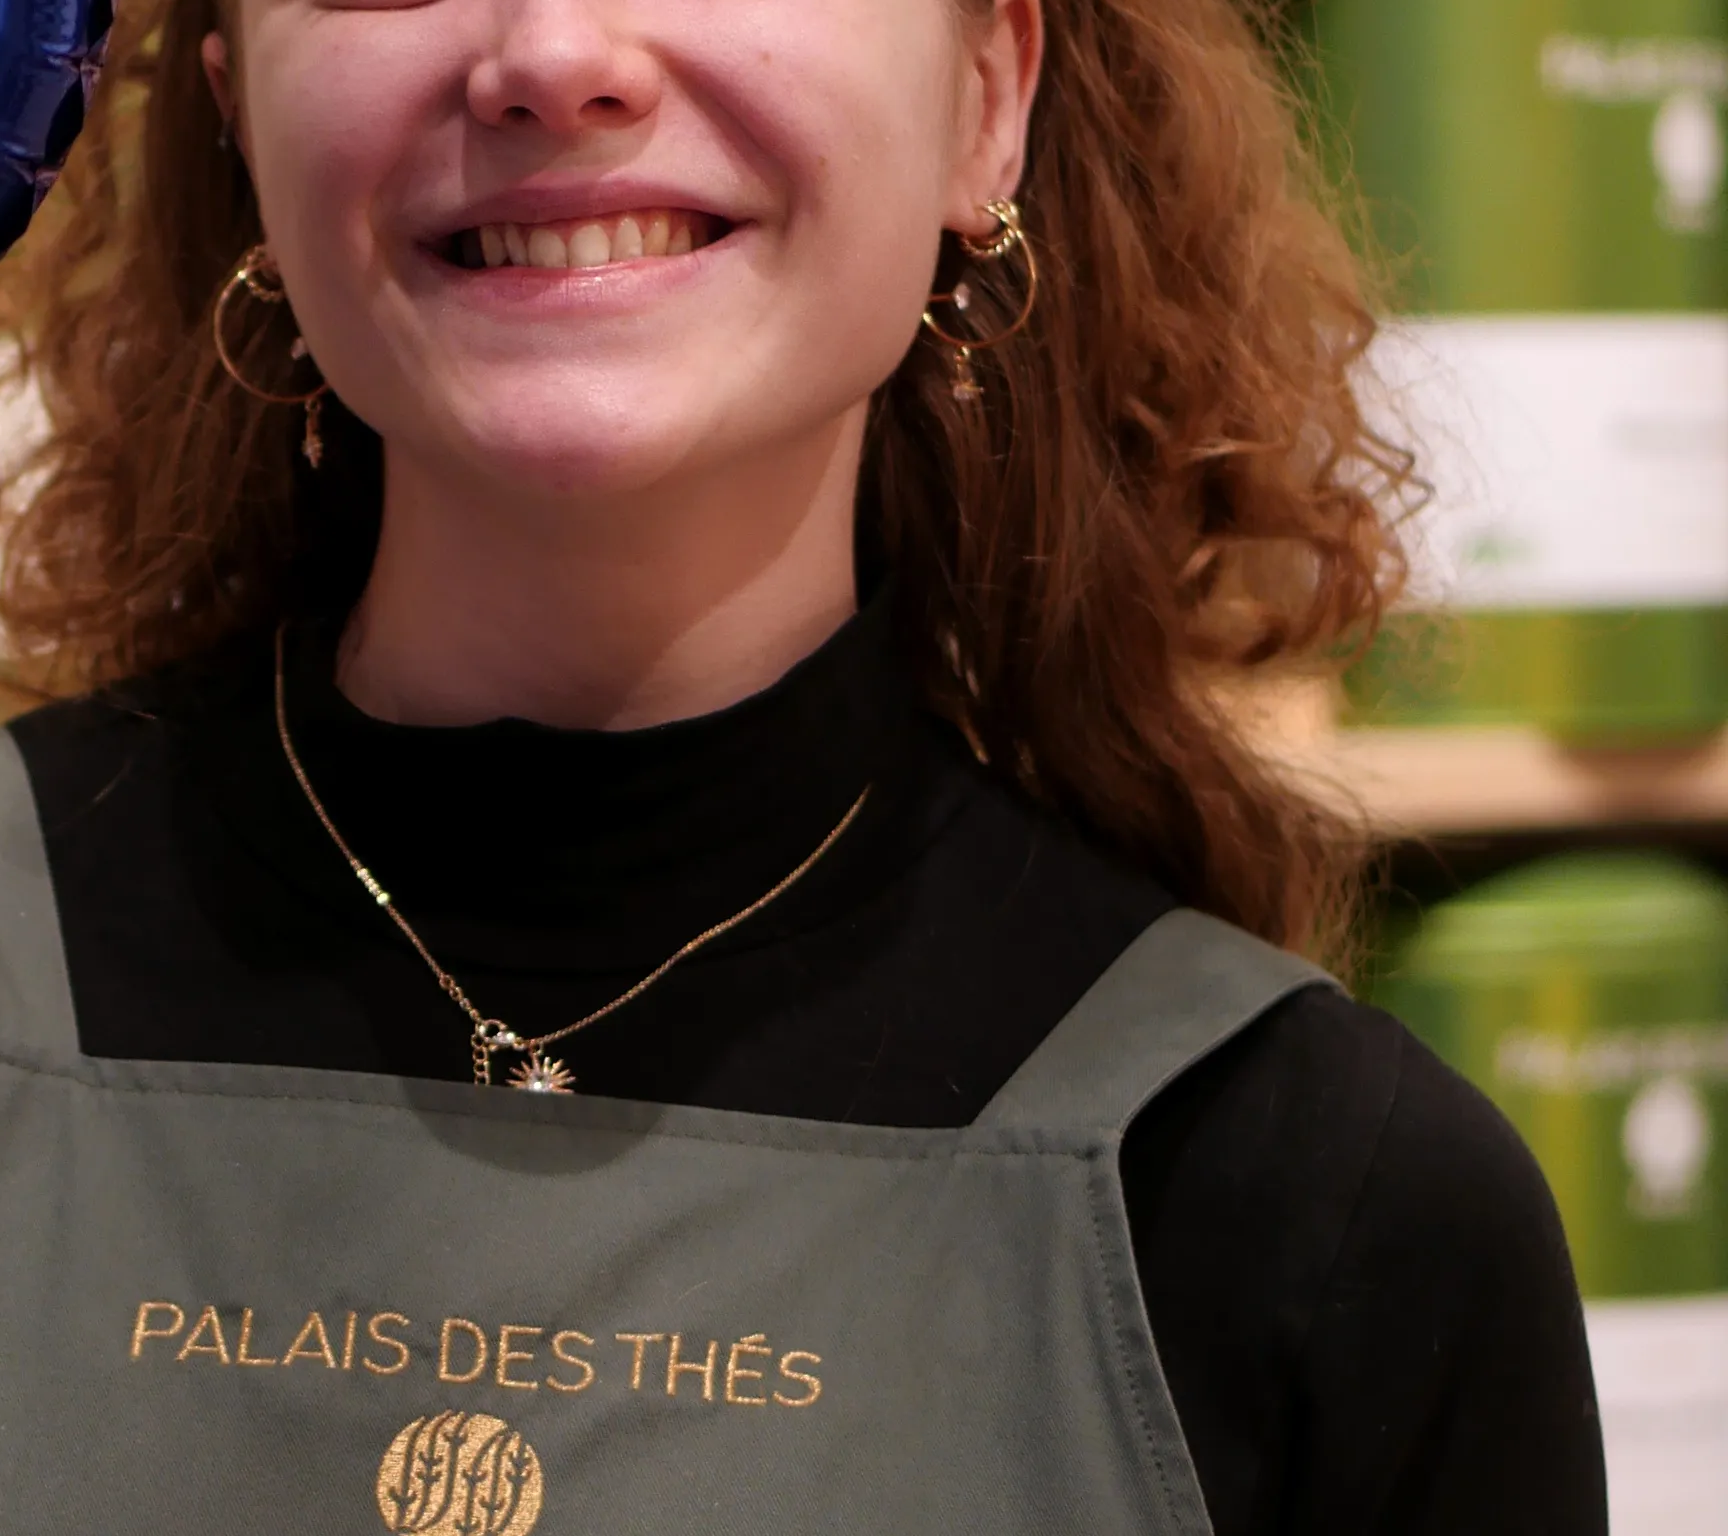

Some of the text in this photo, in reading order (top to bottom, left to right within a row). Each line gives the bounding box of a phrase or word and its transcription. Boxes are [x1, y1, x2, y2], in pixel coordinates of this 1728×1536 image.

[130, 1301, 822, 1408] PALAIS DES THÉS
